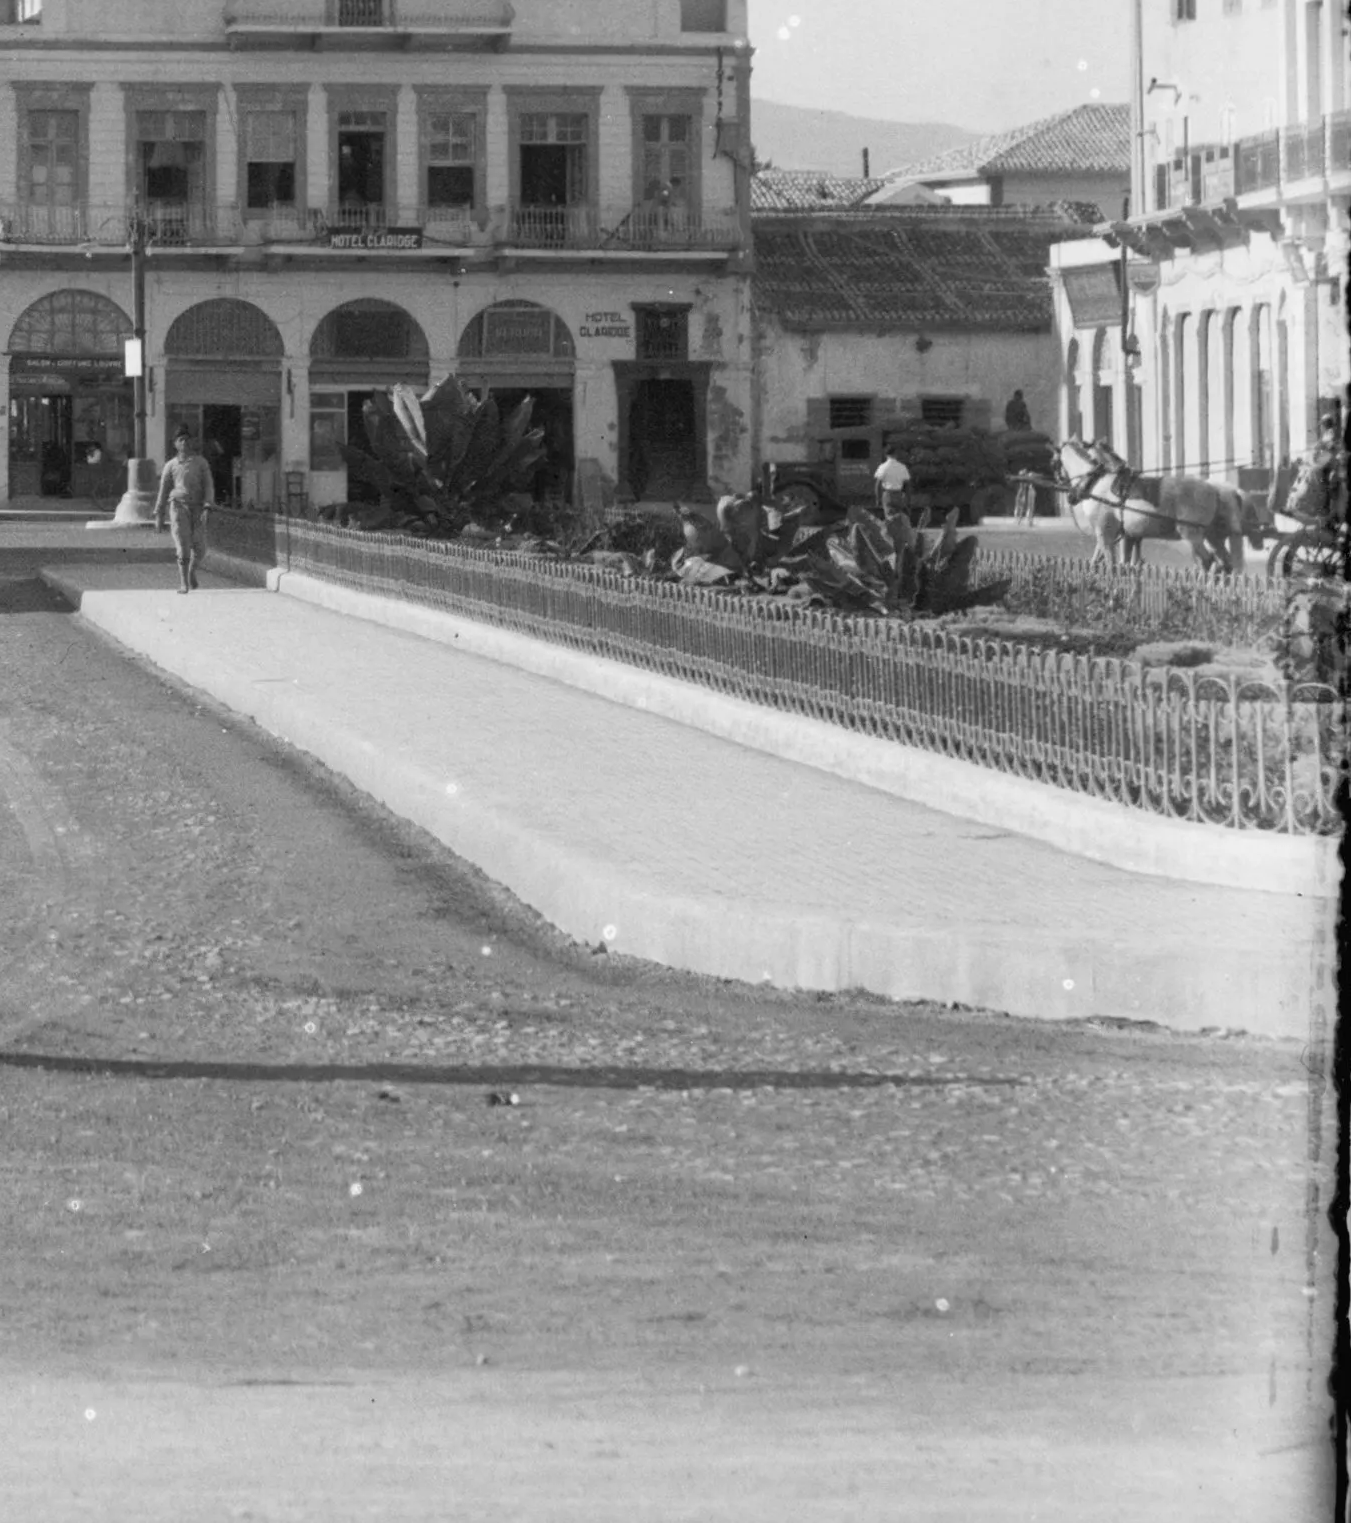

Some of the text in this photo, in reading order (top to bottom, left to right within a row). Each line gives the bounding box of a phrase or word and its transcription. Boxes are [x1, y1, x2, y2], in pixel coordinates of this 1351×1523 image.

[330, 234, 418, 248] HOTEL CLARIDGE
[585, 311, 627, 323] HOTEL
[579, 325, 631, 338] CLARIDGE
